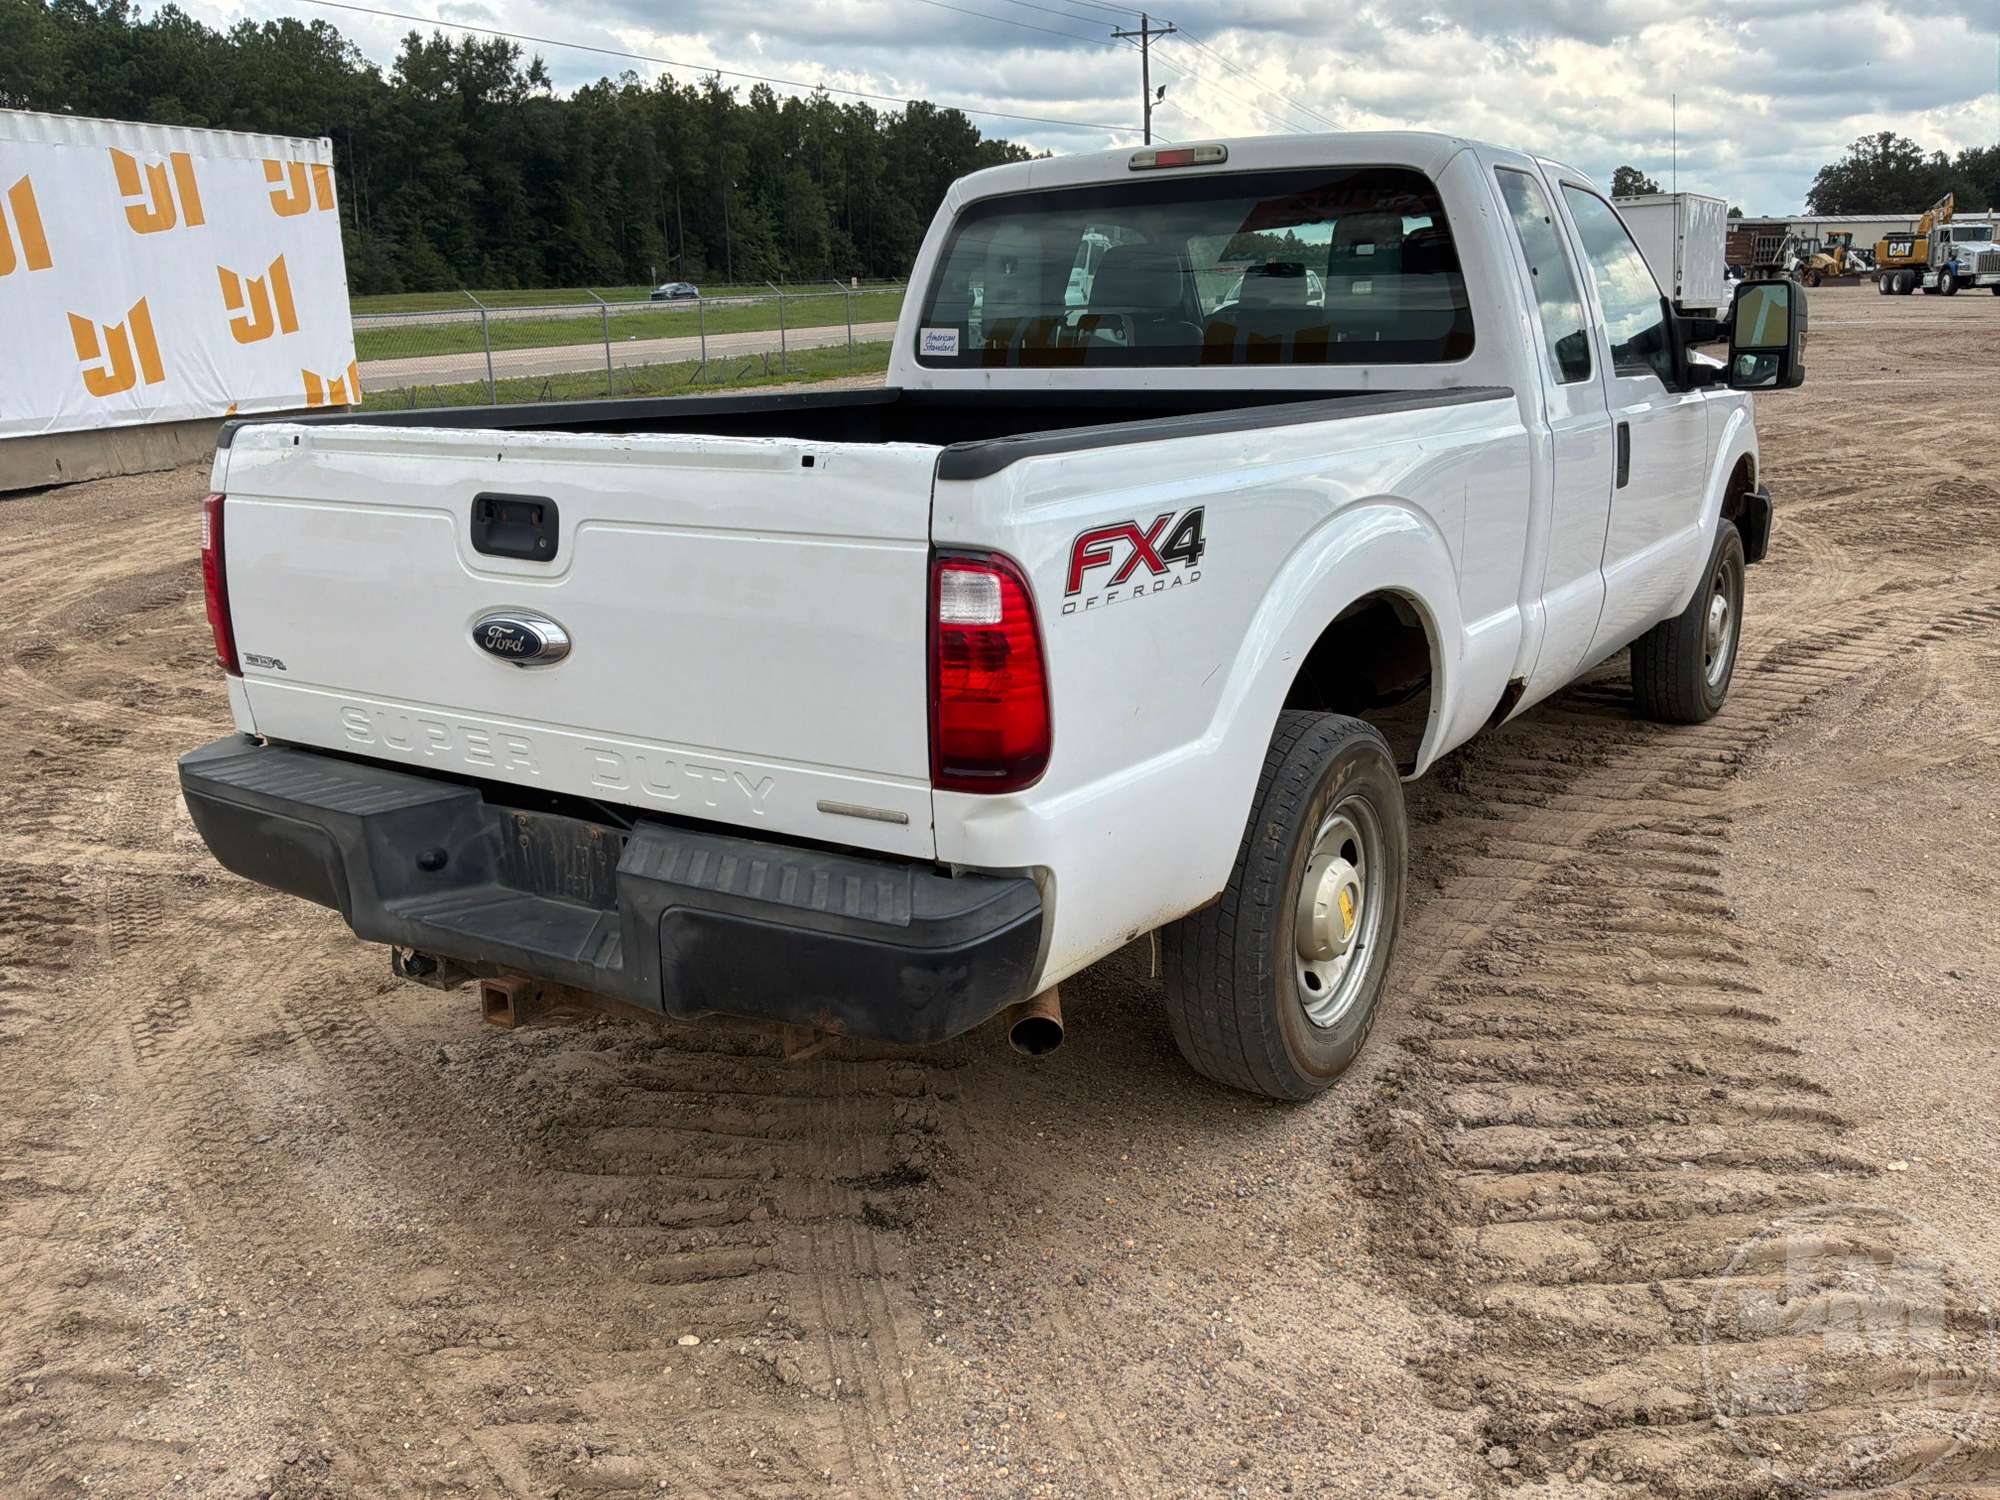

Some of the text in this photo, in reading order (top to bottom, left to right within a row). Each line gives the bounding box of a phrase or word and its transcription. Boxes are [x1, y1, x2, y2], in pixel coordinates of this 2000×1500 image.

[1888, 242, 1912, 256] CAT
[1064, 505, 1206, 597] FX4
[1061, 570, 1202, 616] OFF ROAD
[485, 625, 525, 653] Ford
[340, 705, 776, 815] SUPER DUTY
